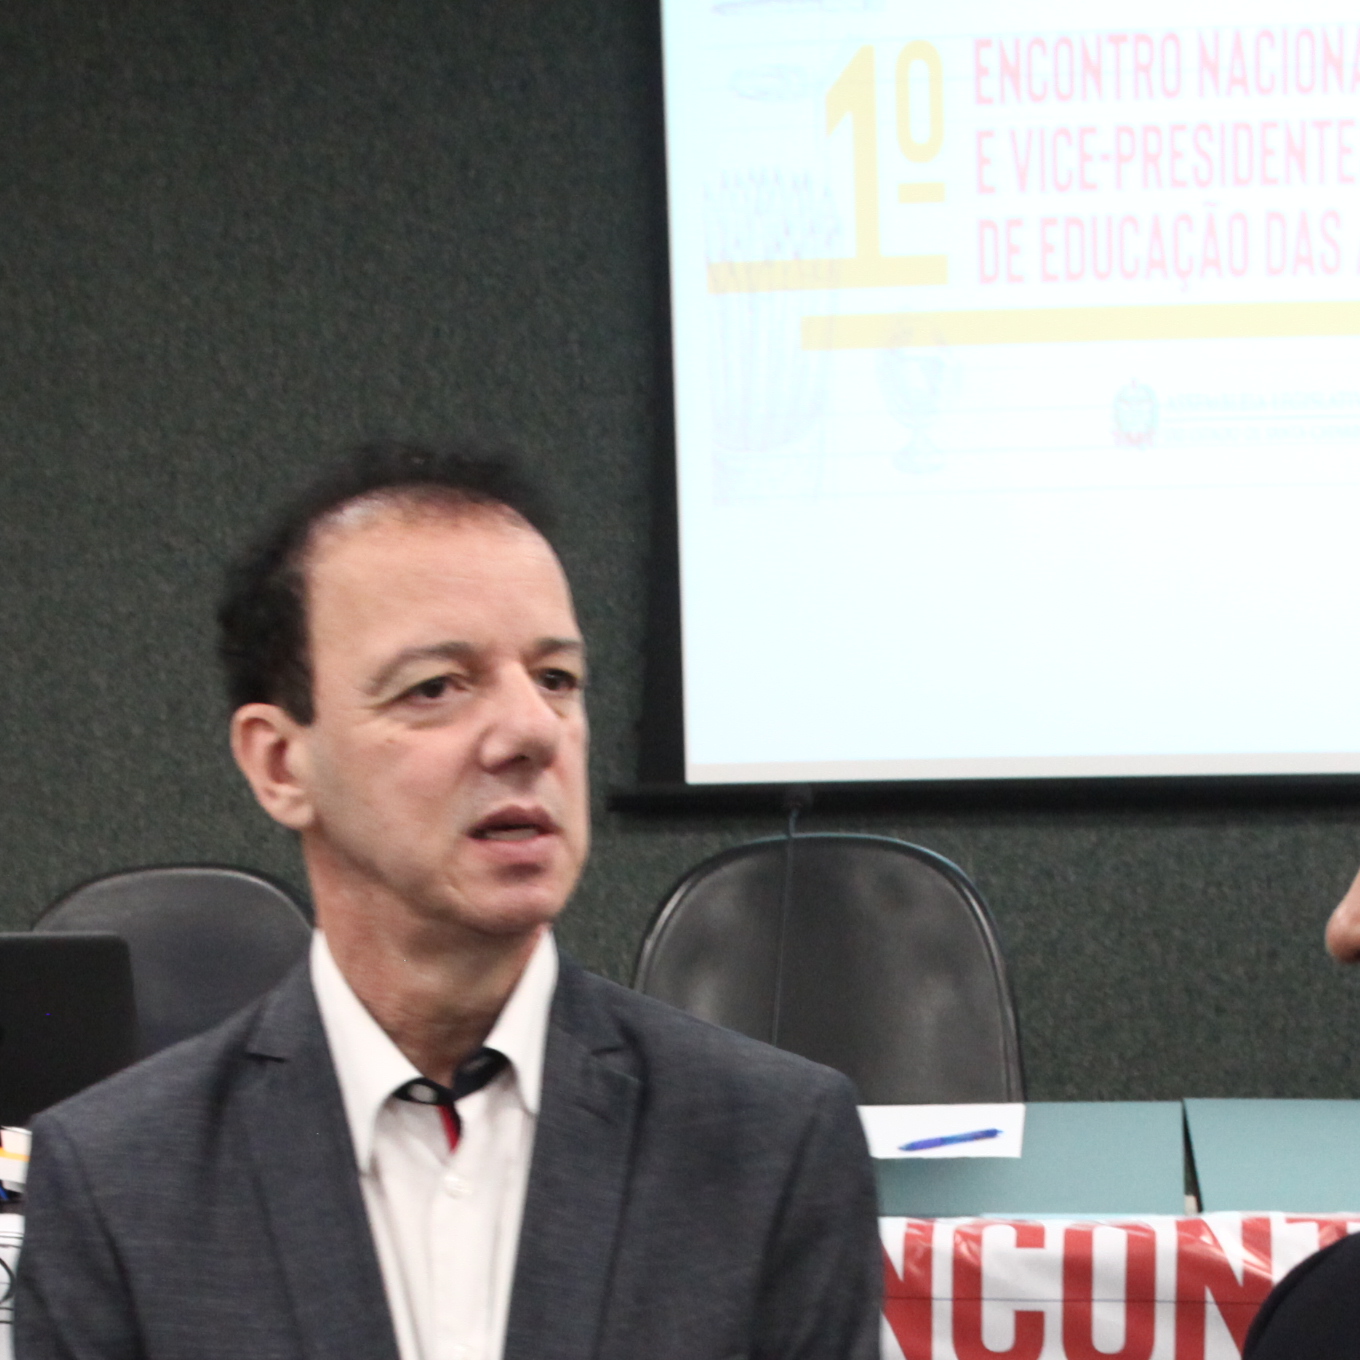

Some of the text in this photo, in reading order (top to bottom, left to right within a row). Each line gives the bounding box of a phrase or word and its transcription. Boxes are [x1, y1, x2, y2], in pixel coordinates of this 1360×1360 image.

[973, 32, 1183, 106] ENCONTRO
[976, 129, 996, 195] E
[978, 218, 1026, 285] DE
[1041, 202, 1250, 291] EDUCAÇÃO
[1265, 210, 1342, 277] DAS
